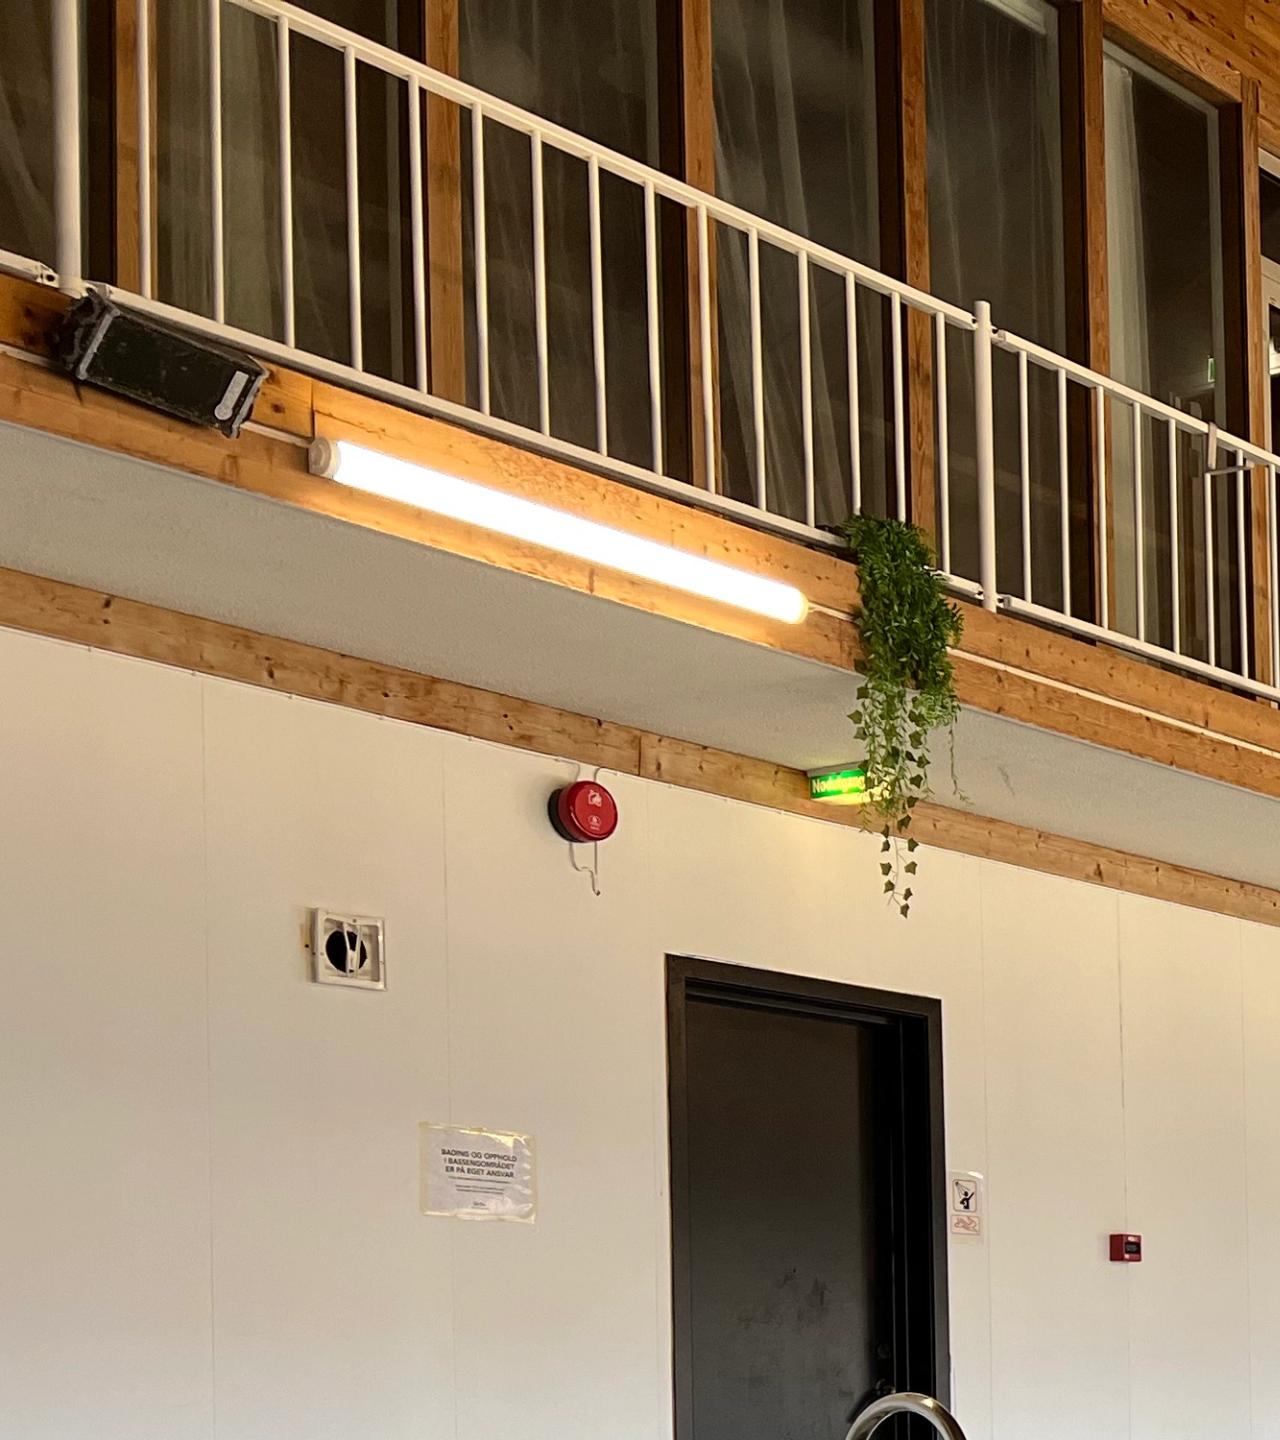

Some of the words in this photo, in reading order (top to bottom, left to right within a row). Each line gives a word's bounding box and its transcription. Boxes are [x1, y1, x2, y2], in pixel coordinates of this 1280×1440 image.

[441, 1149, 470, 1157] BADING
[471, 1151, 483, 1159] OG
[484, 1153, 517, 1162] OPPHOLD
[486, 1170, 514, 1178] ANSVAR
